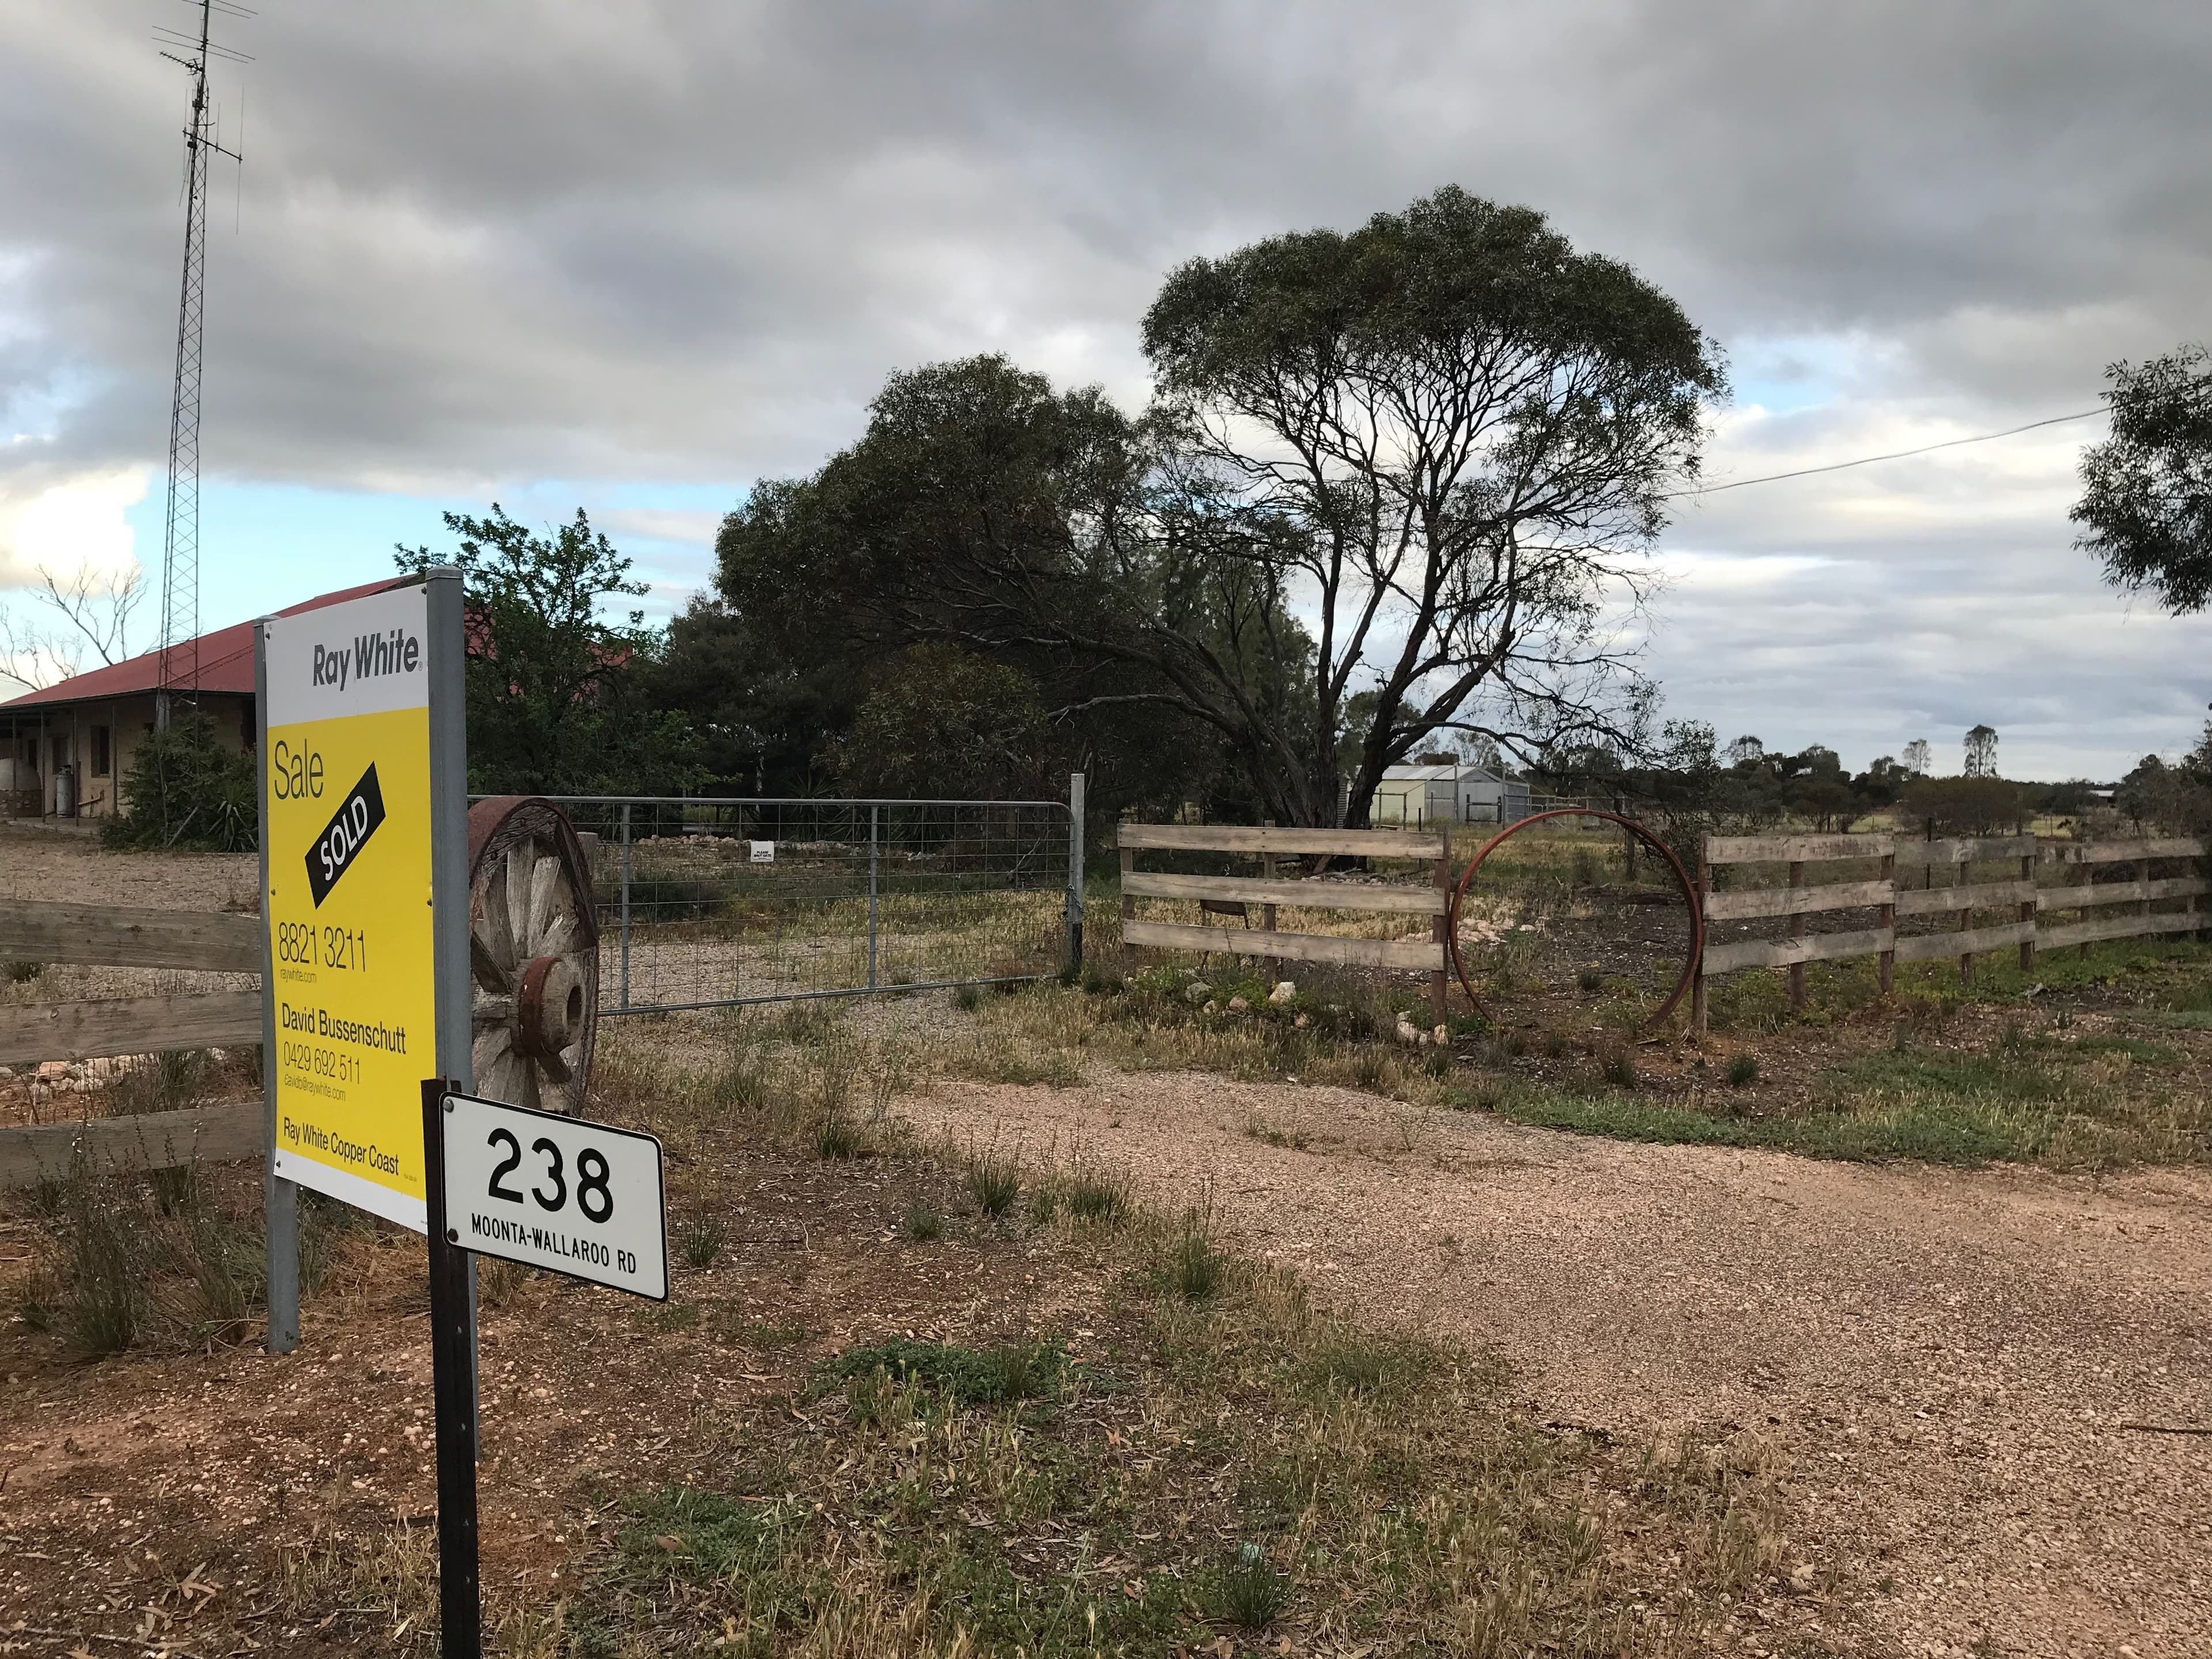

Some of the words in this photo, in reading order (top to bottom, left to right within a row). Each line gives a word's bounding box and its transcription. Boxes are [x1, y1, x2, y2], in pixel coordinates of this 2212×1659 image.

[313, 644, 351, 691] Ray
[355, 628, 418, 679] White
[274, 738, 324, 800] Sale
[320, 796, 368, 881] SOLD
[279, 922, 317, 965] 8821
[324, 926, 365, 972] 3211
[281, 968, 317, 983] raywhite.com
[282, 1002, 315, 1034] David
[319, 1009, 406, 1054] Bussenschutt
[283, 1041, 310, 1071] 0429
[315, 1048, 335, 1077] 692
[340, 1054, 359, 1084] 511
[284, 1116, 300, 1146] Ray
[302, 1122, 328, 1151] White
[331, 1132, 366, 1165] Copper
[369, 1145, 399, 1175] Coast
[487, 1128, 613, 1224] 238
[471, 1213, 609, 1267] MOONTA-WALLAROO
[617, 1249, 636, 1274] RD
